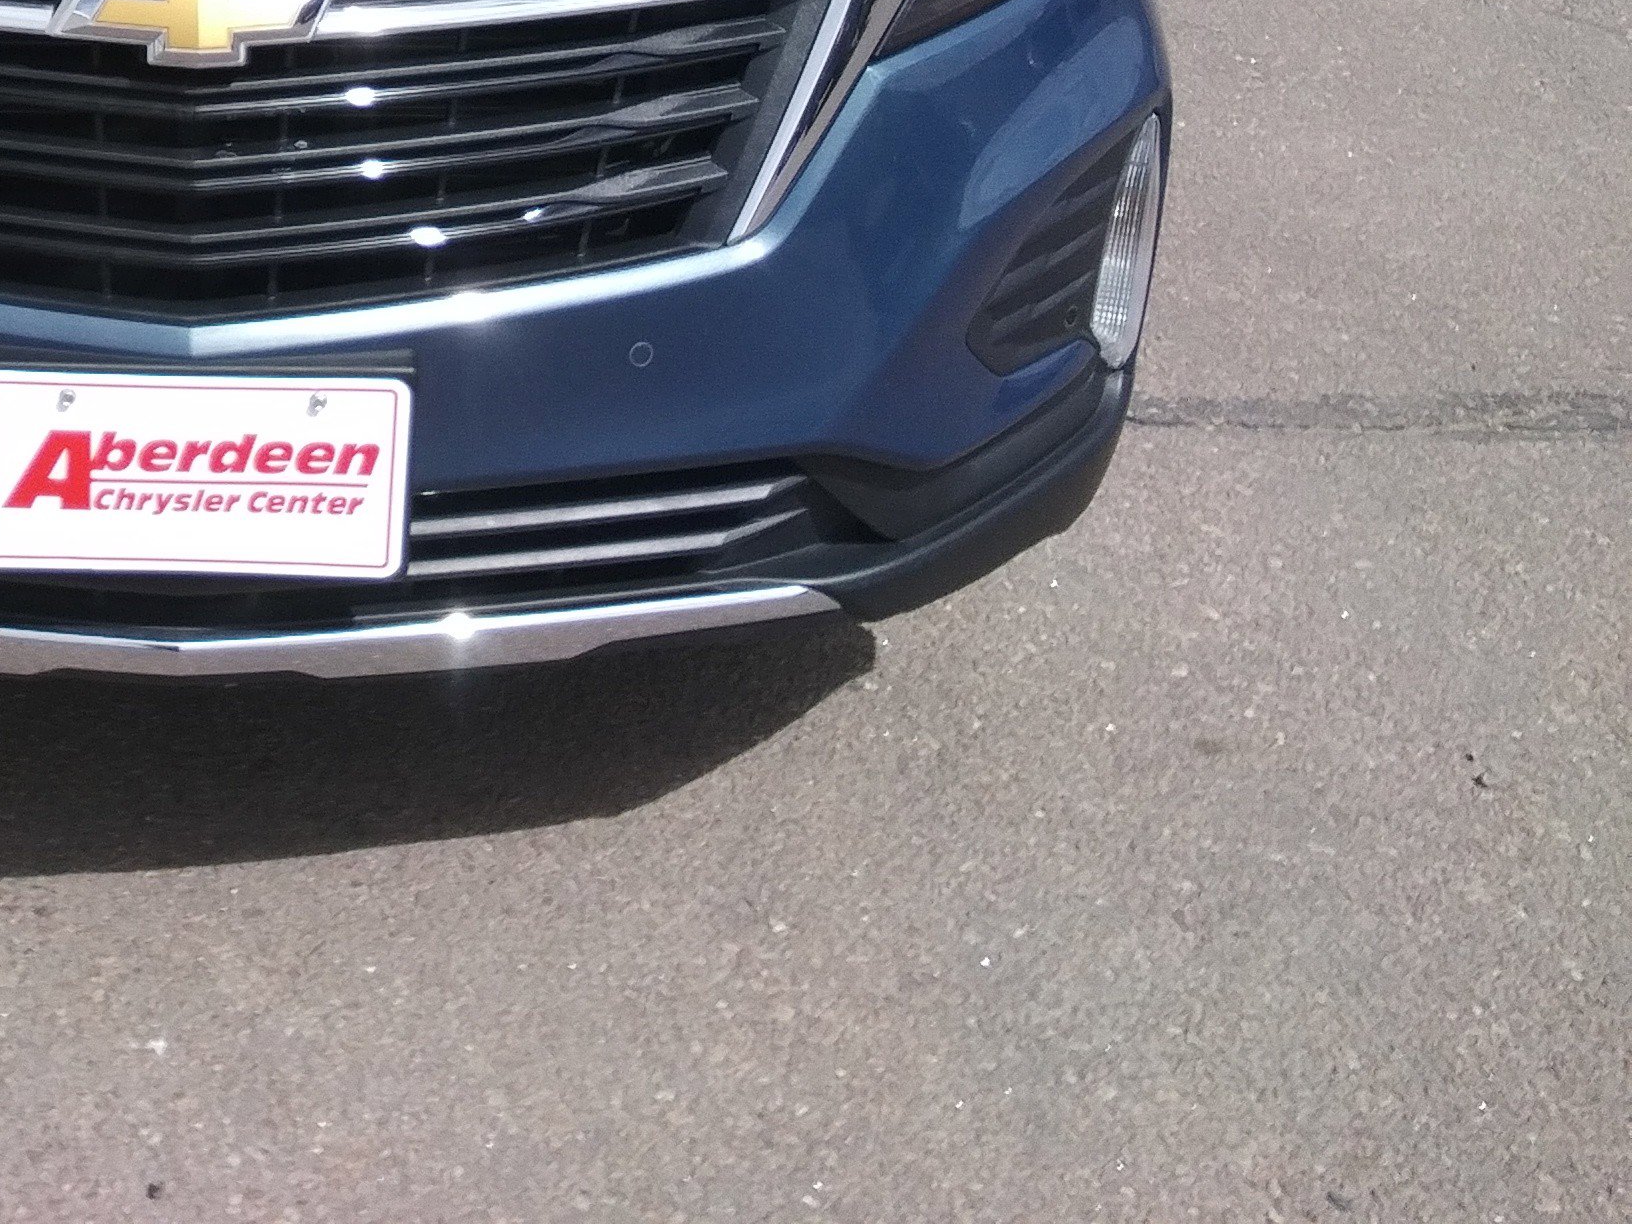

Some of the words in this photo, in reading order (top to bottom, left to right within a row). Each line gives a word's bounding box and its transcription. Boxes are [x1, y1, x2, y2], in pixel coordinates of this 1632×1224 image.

[2, 429, 381, 511] Aberdeen
[92, 487, 241, 516] Chrysler
[246, 490, 366, 516] Center
